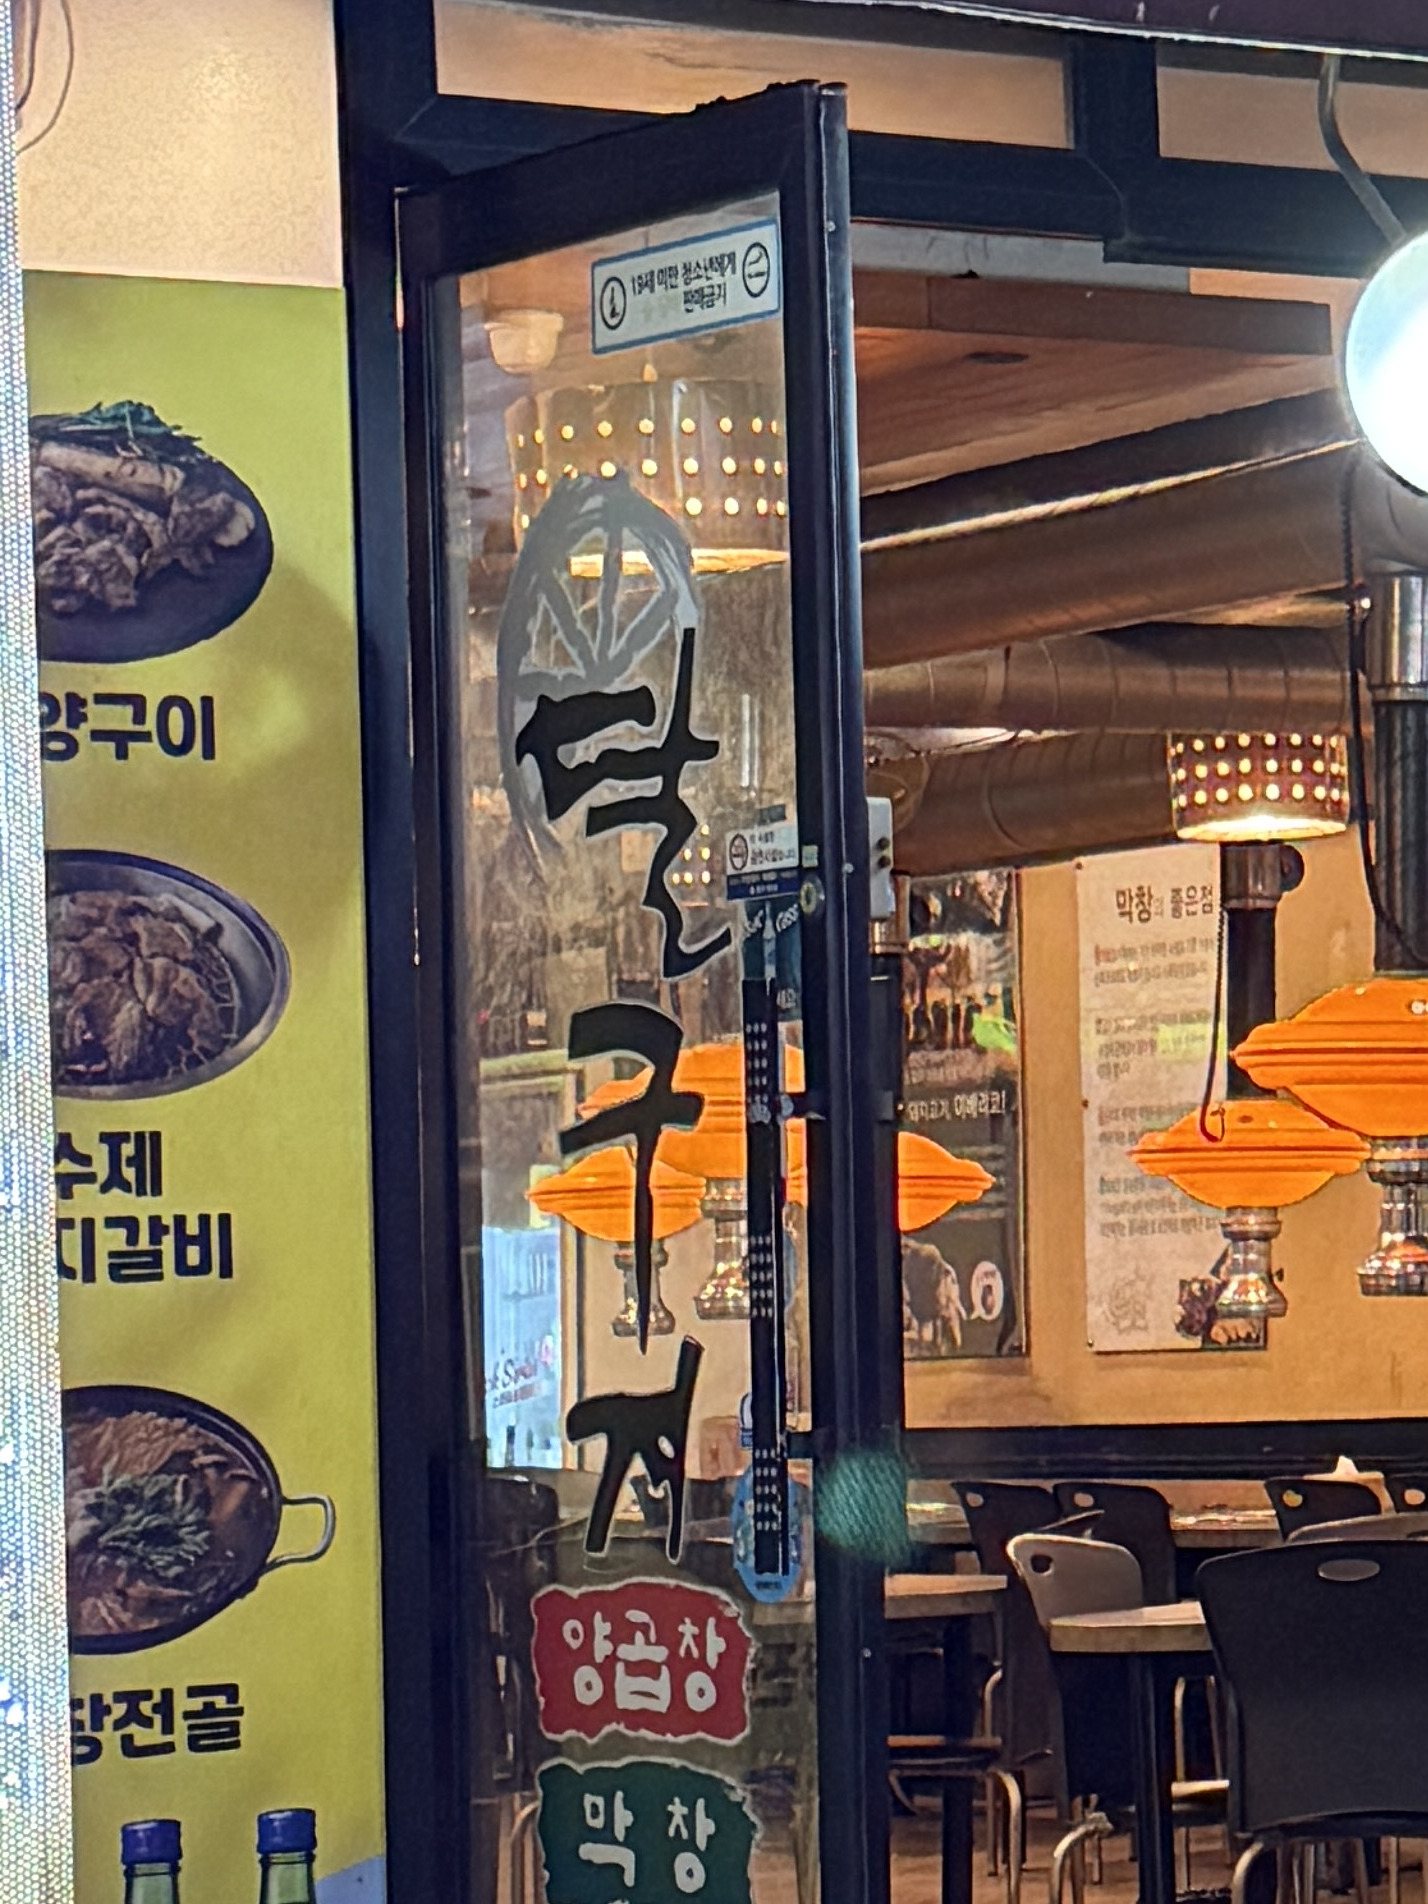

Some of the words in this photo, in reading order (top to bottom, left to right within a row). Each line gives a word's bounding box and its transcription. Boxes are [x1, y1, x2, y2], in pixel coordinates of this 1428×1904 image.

[39, 692, 216, 761] 양구이
[55, 1130, 163, 1200] 수제
[562, 1610, 726, 1712] 양곱창
